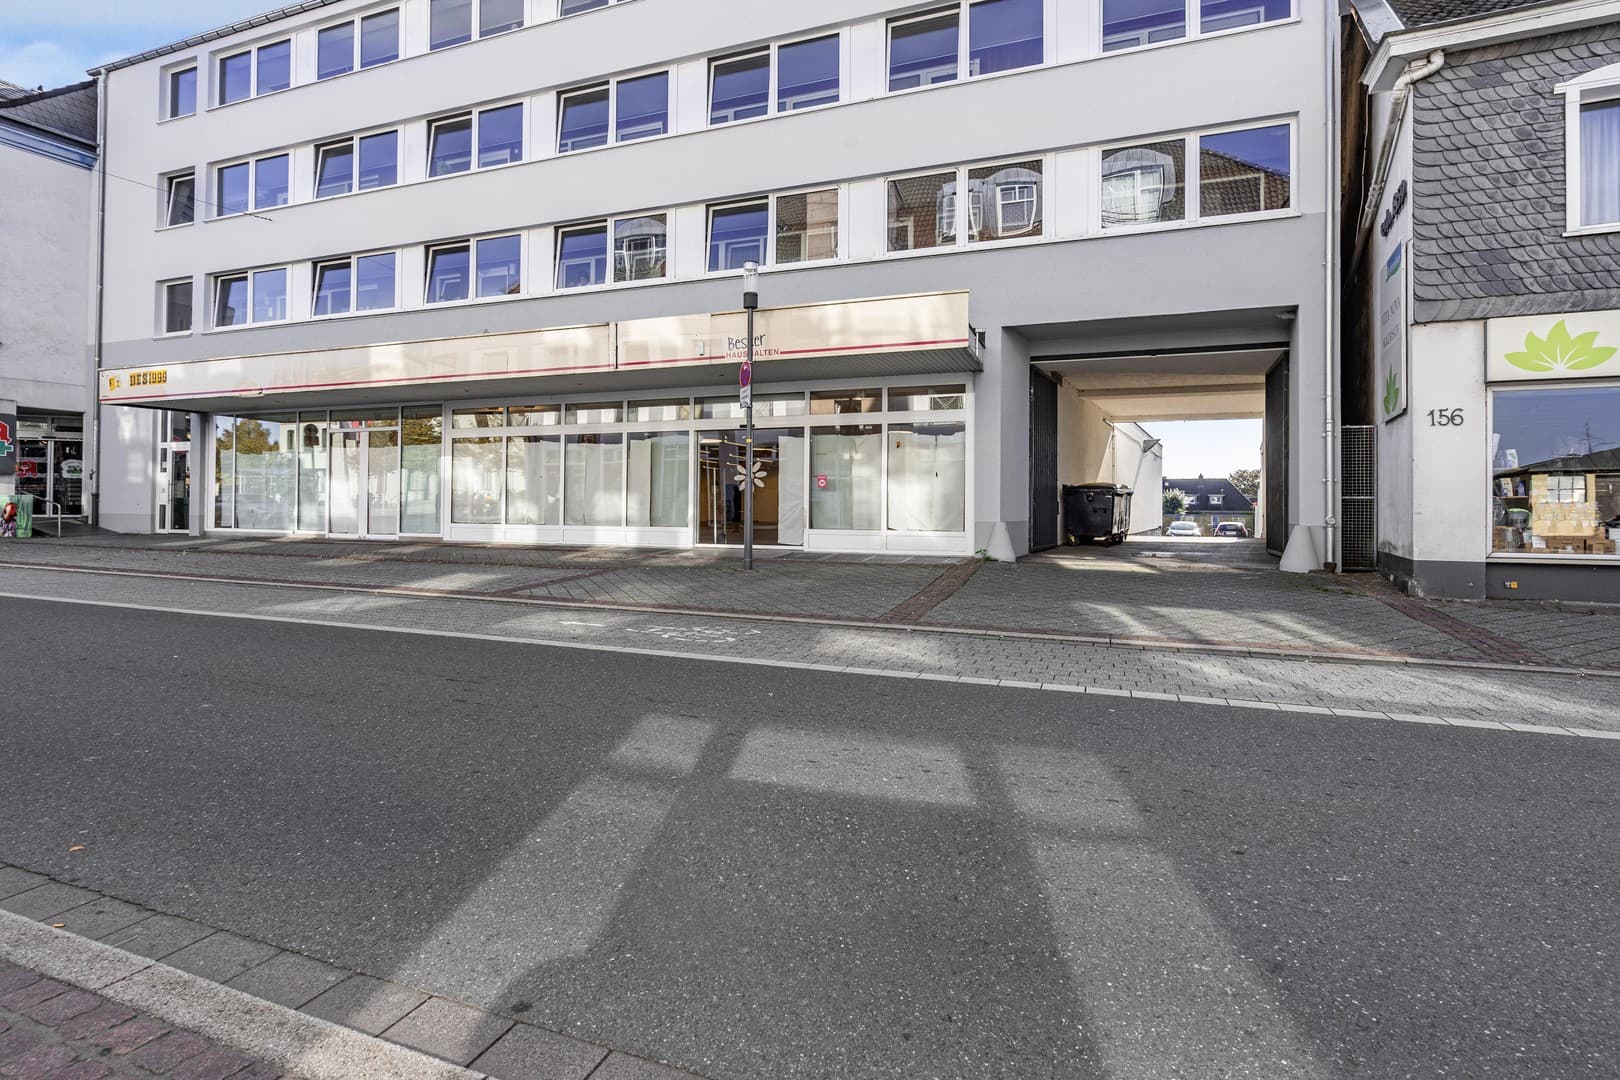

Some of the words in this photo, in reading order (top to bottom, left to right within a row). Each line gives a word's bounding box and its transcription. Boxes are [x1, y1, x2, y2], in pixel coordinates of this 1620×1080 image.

[727, 334, 766, 351] Beser
[725, 348, 780, 359] HAUSALTEN
[1426, 407, 1464, 427] 156
